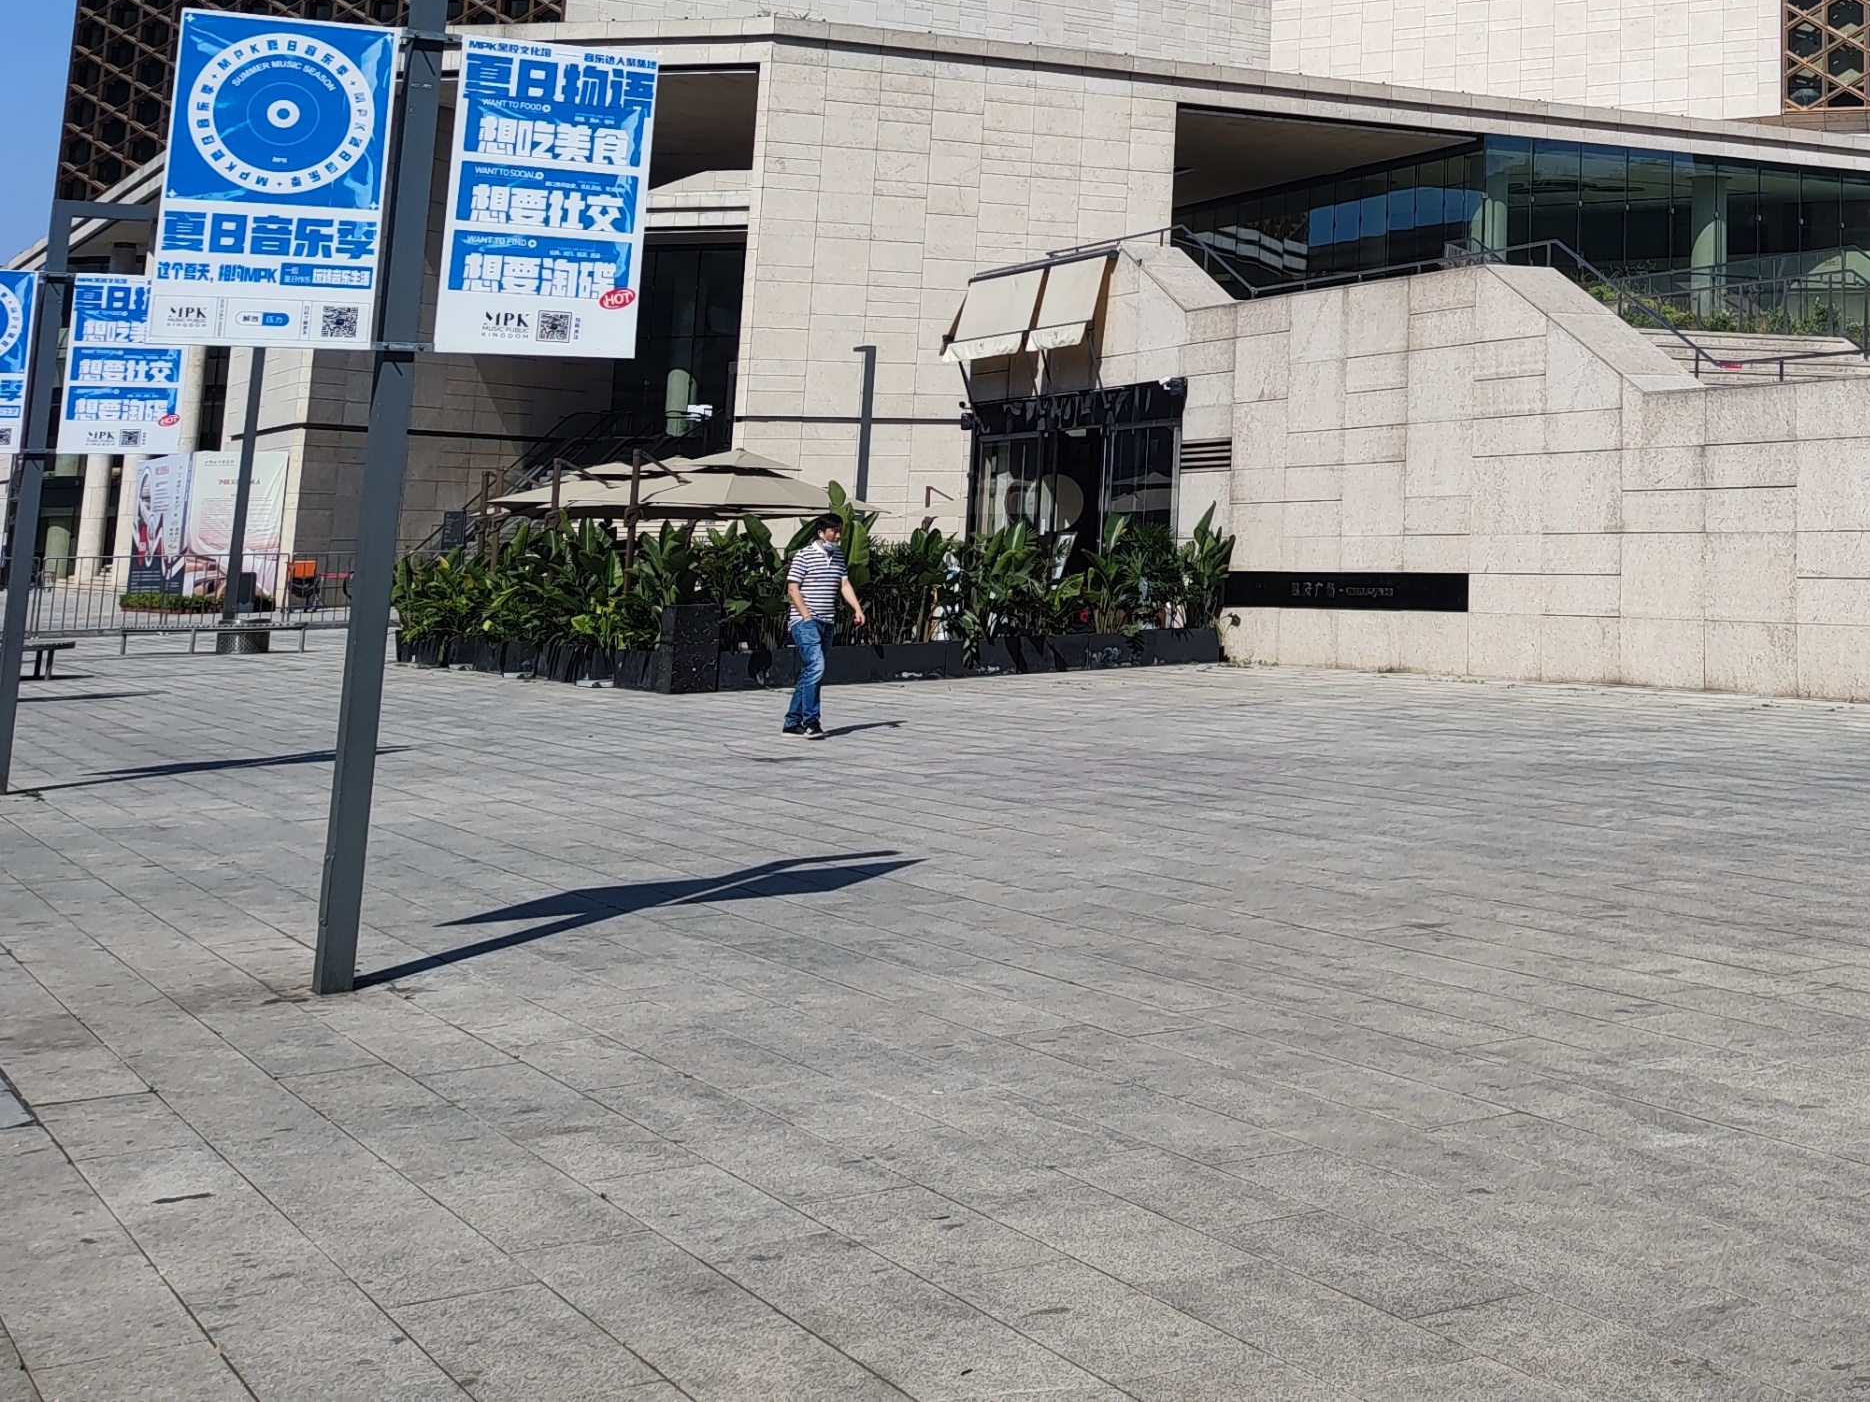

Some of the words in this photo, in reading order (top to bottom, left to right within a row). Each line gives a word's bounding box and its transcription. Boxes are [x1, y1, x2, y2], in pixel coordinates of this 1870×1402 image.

[231, 62, 271, 87] SUMMER
[271, 60, 303, 70] MUSIC
[302, 65, 337, 92] SEASON
[463, 53, 656, 111] 夏日物语
[477, 115, 630, 166] 想吃美食
[469, 183, 624, 233] 想要社交
[161, 210, 377, 260] 夏日音乐季
[168, 306, 208, 319] MPK
[605, 292, 632, 306] HOT
[483, 311, 530, 327] MPK
[78, 358, 173, 383] 想要社交
